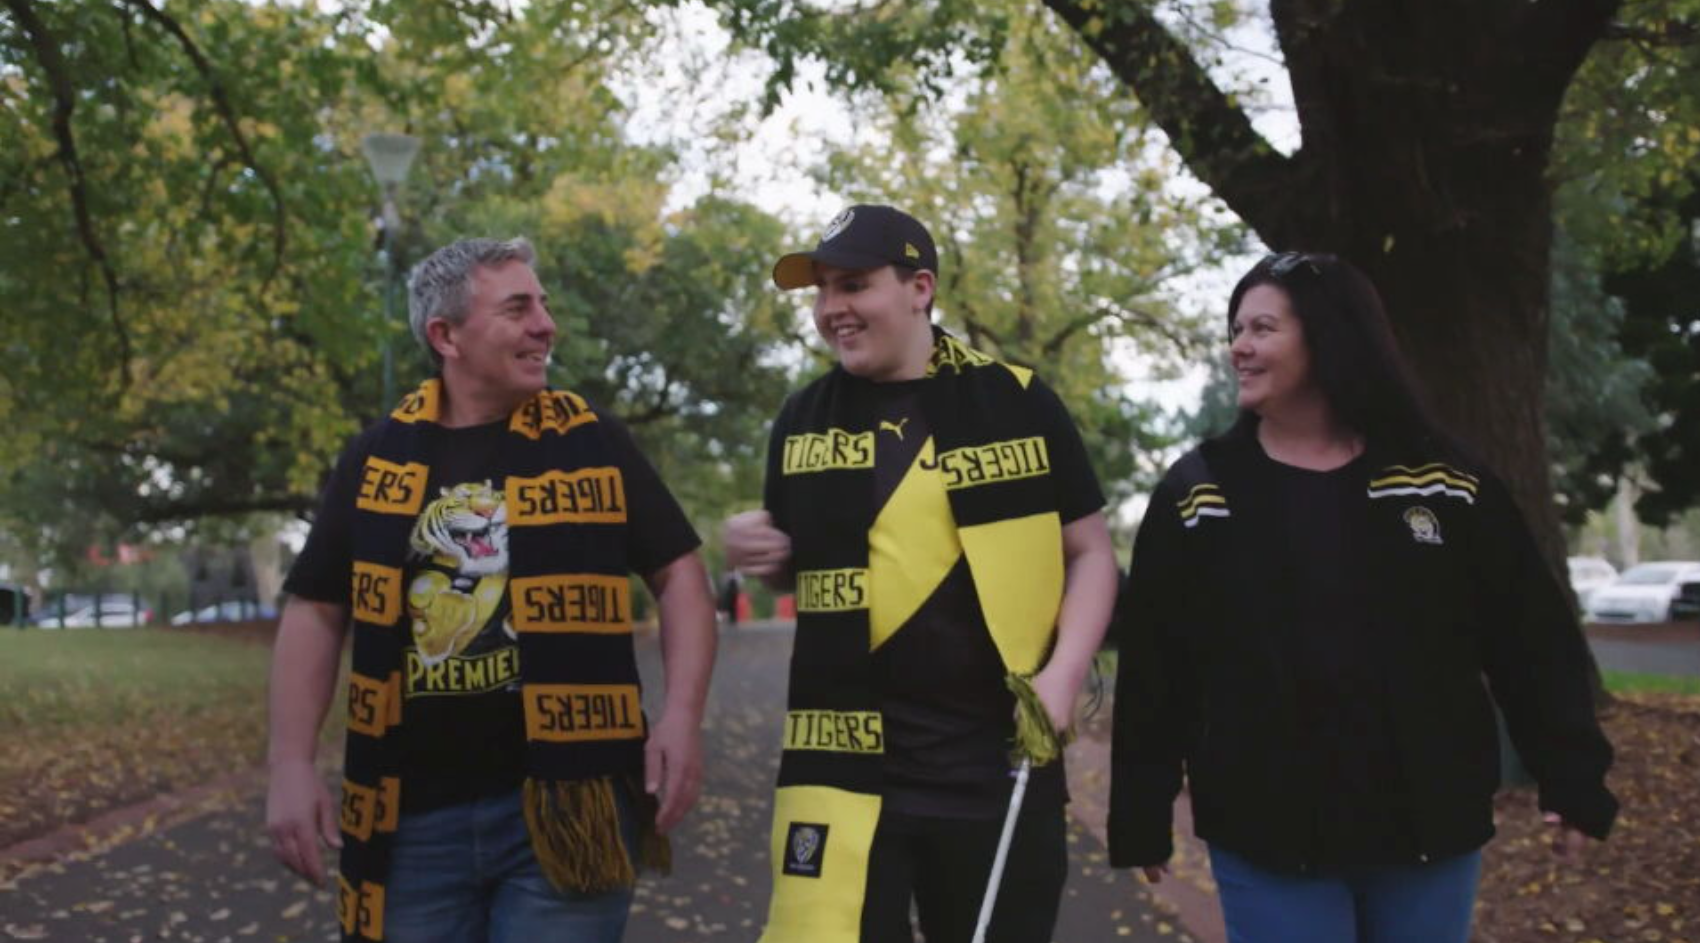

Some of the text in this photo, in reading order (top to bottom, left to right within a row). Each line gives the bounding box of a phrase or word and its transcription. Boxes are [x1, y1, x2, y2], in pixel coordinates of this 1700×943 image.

[940, 440, 1049, 487] TIGERS
[518, 475, 622, 517] TIGERS
[524, 583, 625, 623] TIGERS
[536, 693, 637, 733] TIGERS
[789, 713, 882, 751] TIGERS
